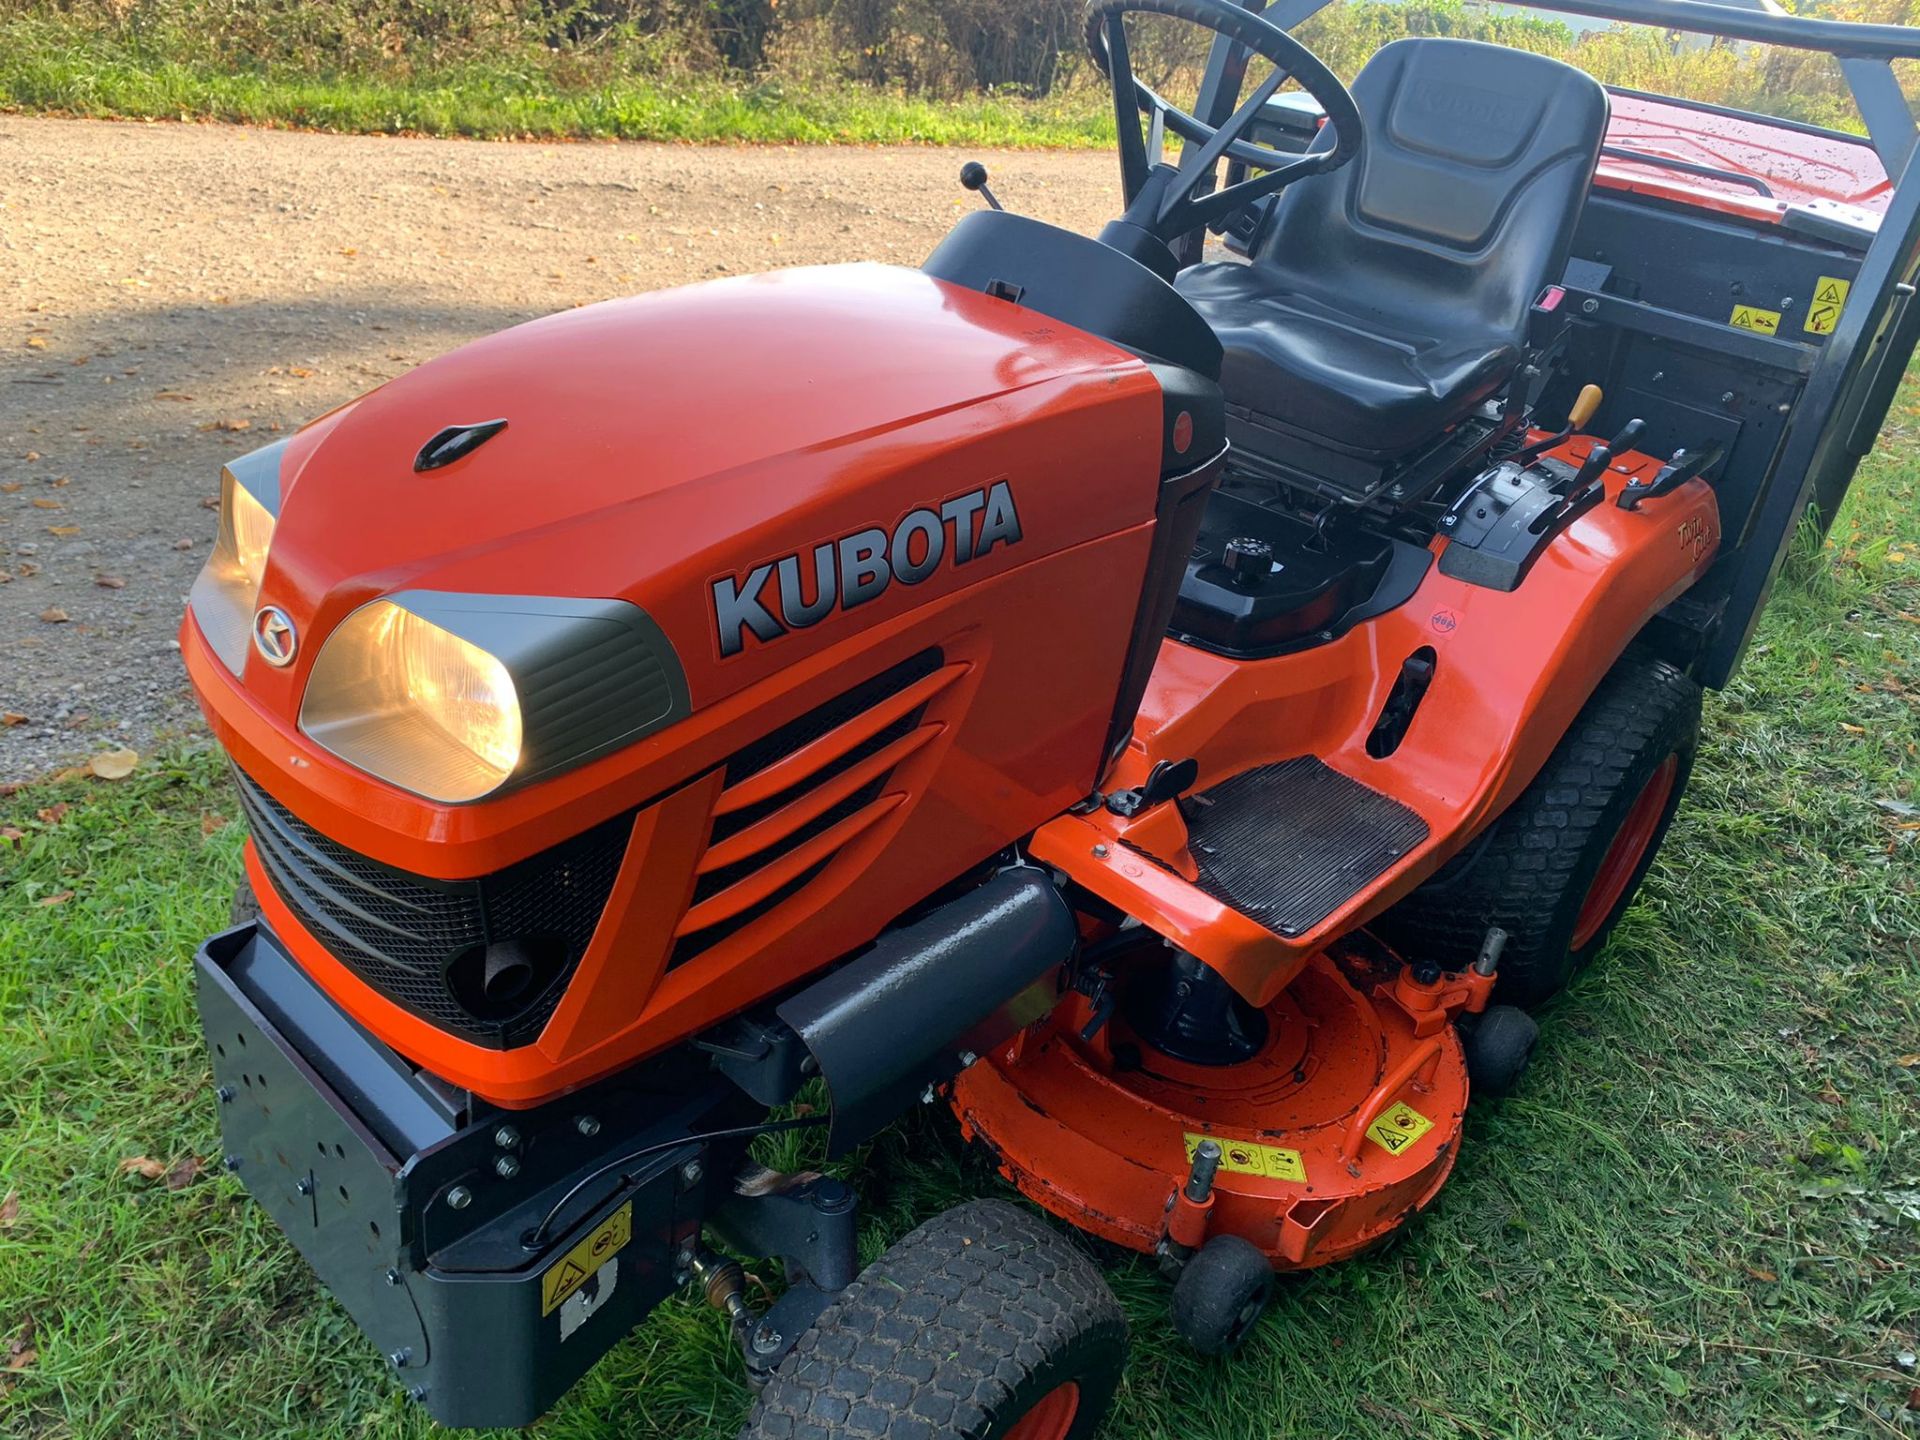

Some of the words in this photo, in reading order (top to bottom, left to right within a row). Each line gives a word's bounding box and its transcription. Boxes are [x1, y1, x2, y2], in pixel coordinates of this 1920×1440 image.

[1677, 516, 1703, 550] Twin
[1692, 525, 1711, 562] Cut
[712, 479, 1023, 660] KUBOTA
